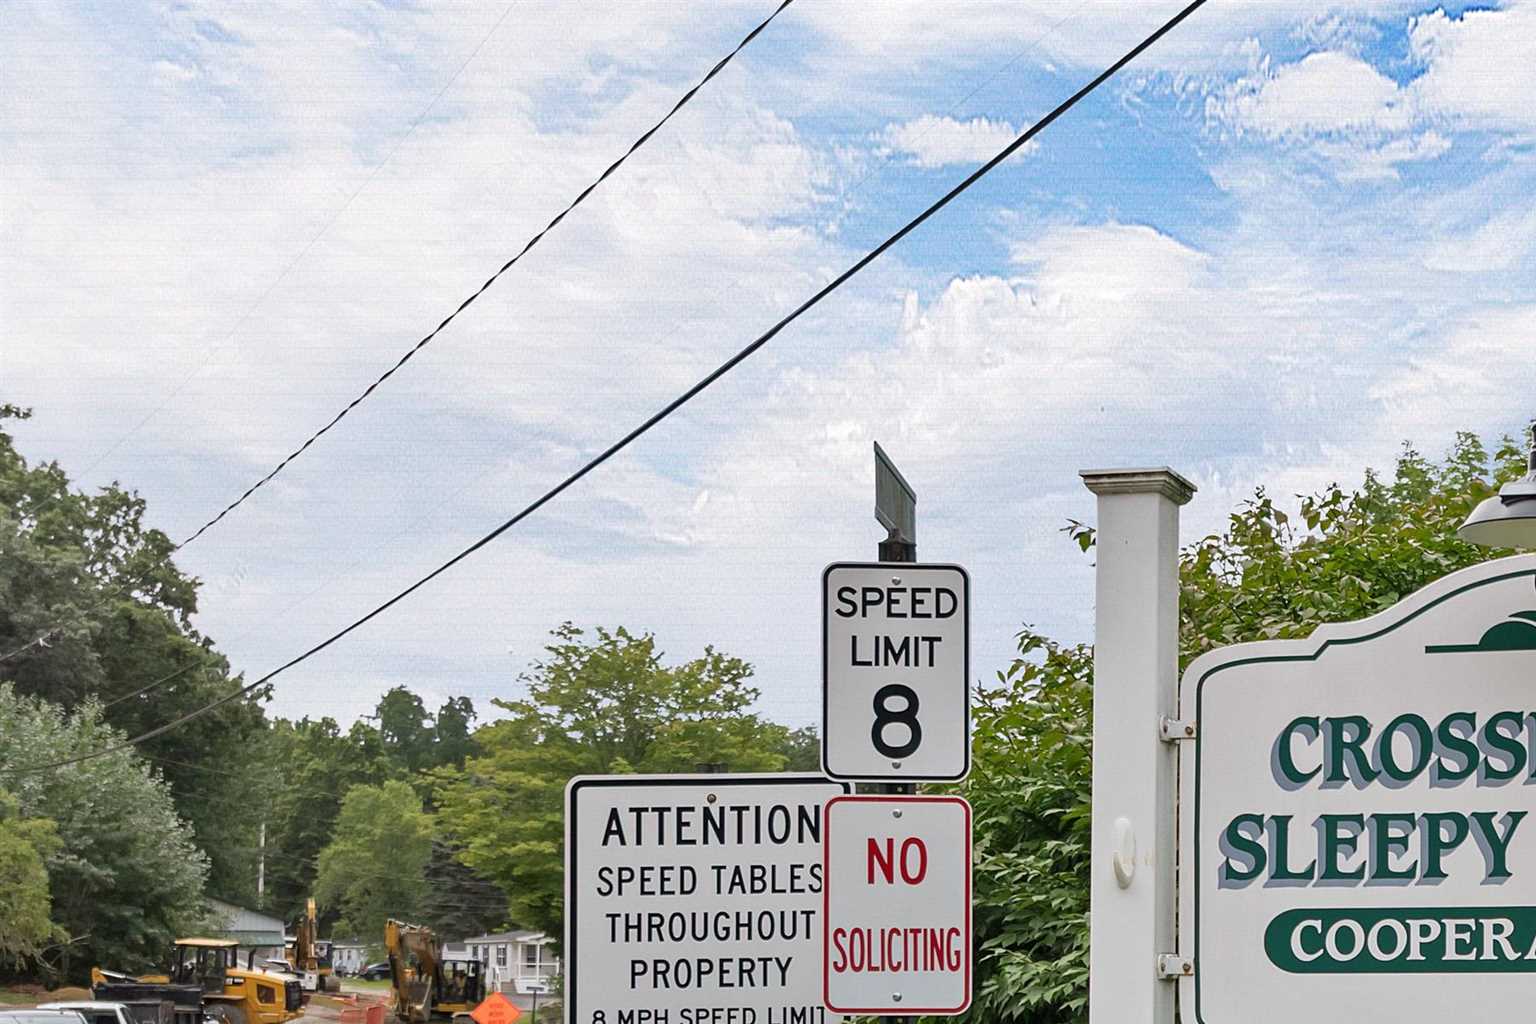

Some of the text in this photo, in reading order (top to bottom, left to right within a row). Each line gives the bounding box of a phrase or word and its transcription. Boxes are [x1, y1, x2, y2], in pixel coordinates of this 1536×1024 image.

[835, 587, 957, 618] SPEED
[852, 635, 942, 667] LIMIT
[871, 684, 922, 758] 8
[602, 805, 821, 846] ATTENTION
[867, 837, 928, 886] NO
[1217, 811, 1528, 890] SLEEPY
[597, 864, 822, 896] SPEED TABLES
[606, 911, 816, 942] THROUGHOUT
[833, 928, 960, 973] SOLICITING
[631, 957, 792, 988] PROPERTY
